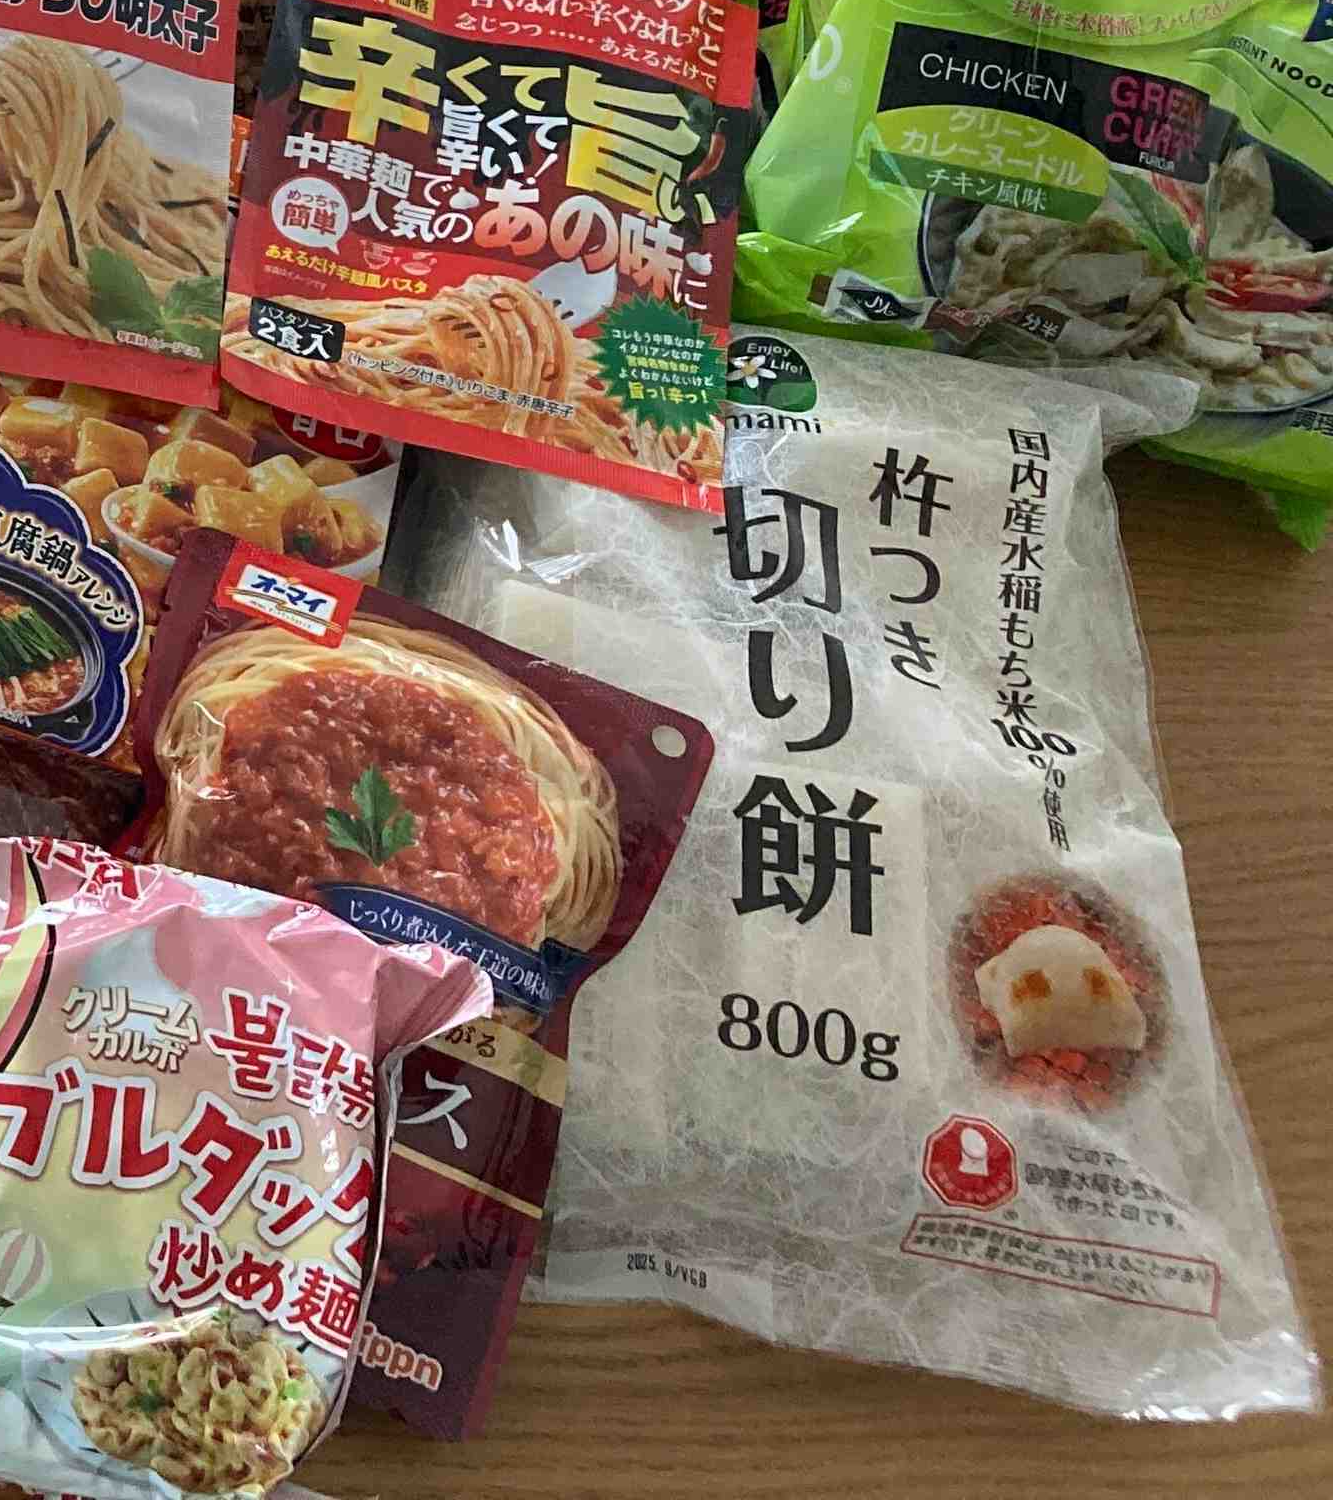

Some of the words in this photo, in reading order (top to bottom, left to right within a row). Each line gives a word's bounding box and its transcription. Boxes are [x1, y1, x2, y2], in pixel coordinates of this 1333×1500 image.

[454, 11, 544, 38] 念じつつ
[599, 37, 719, 91] あえるだけで
[919, 52, 1069, 106] CHICKEN
[948, 106, 1053, 149] グリーン
[283, 131, 452, 208] 中華麺で
[901, 126, 1085, 188] カレーヌードル
[925, 168, 1048, 212] チキン風味
[282, 202, 340, 237] 簡単
[256, 316, 333, 362] 2食入
[258, 303, 335, 337] パスタソース
[746, 342, 793, 359] Enjoy
[769, 358, 805, 377] Life!
[252, 571, 330, 612] オーマイ
[868, 447, 955, 690] 杵つき
[989, 427, 1079, 854] 国内産水稲もち米100%使用
[712, 485, 886, 936] 切り餅
[62, 986, 201, 1044] クリーム
[716, 993, 902, 1082] 800g
[89, 1028, 191, 1074] カルボ
[354, 1322, 443, 1392] ippn
